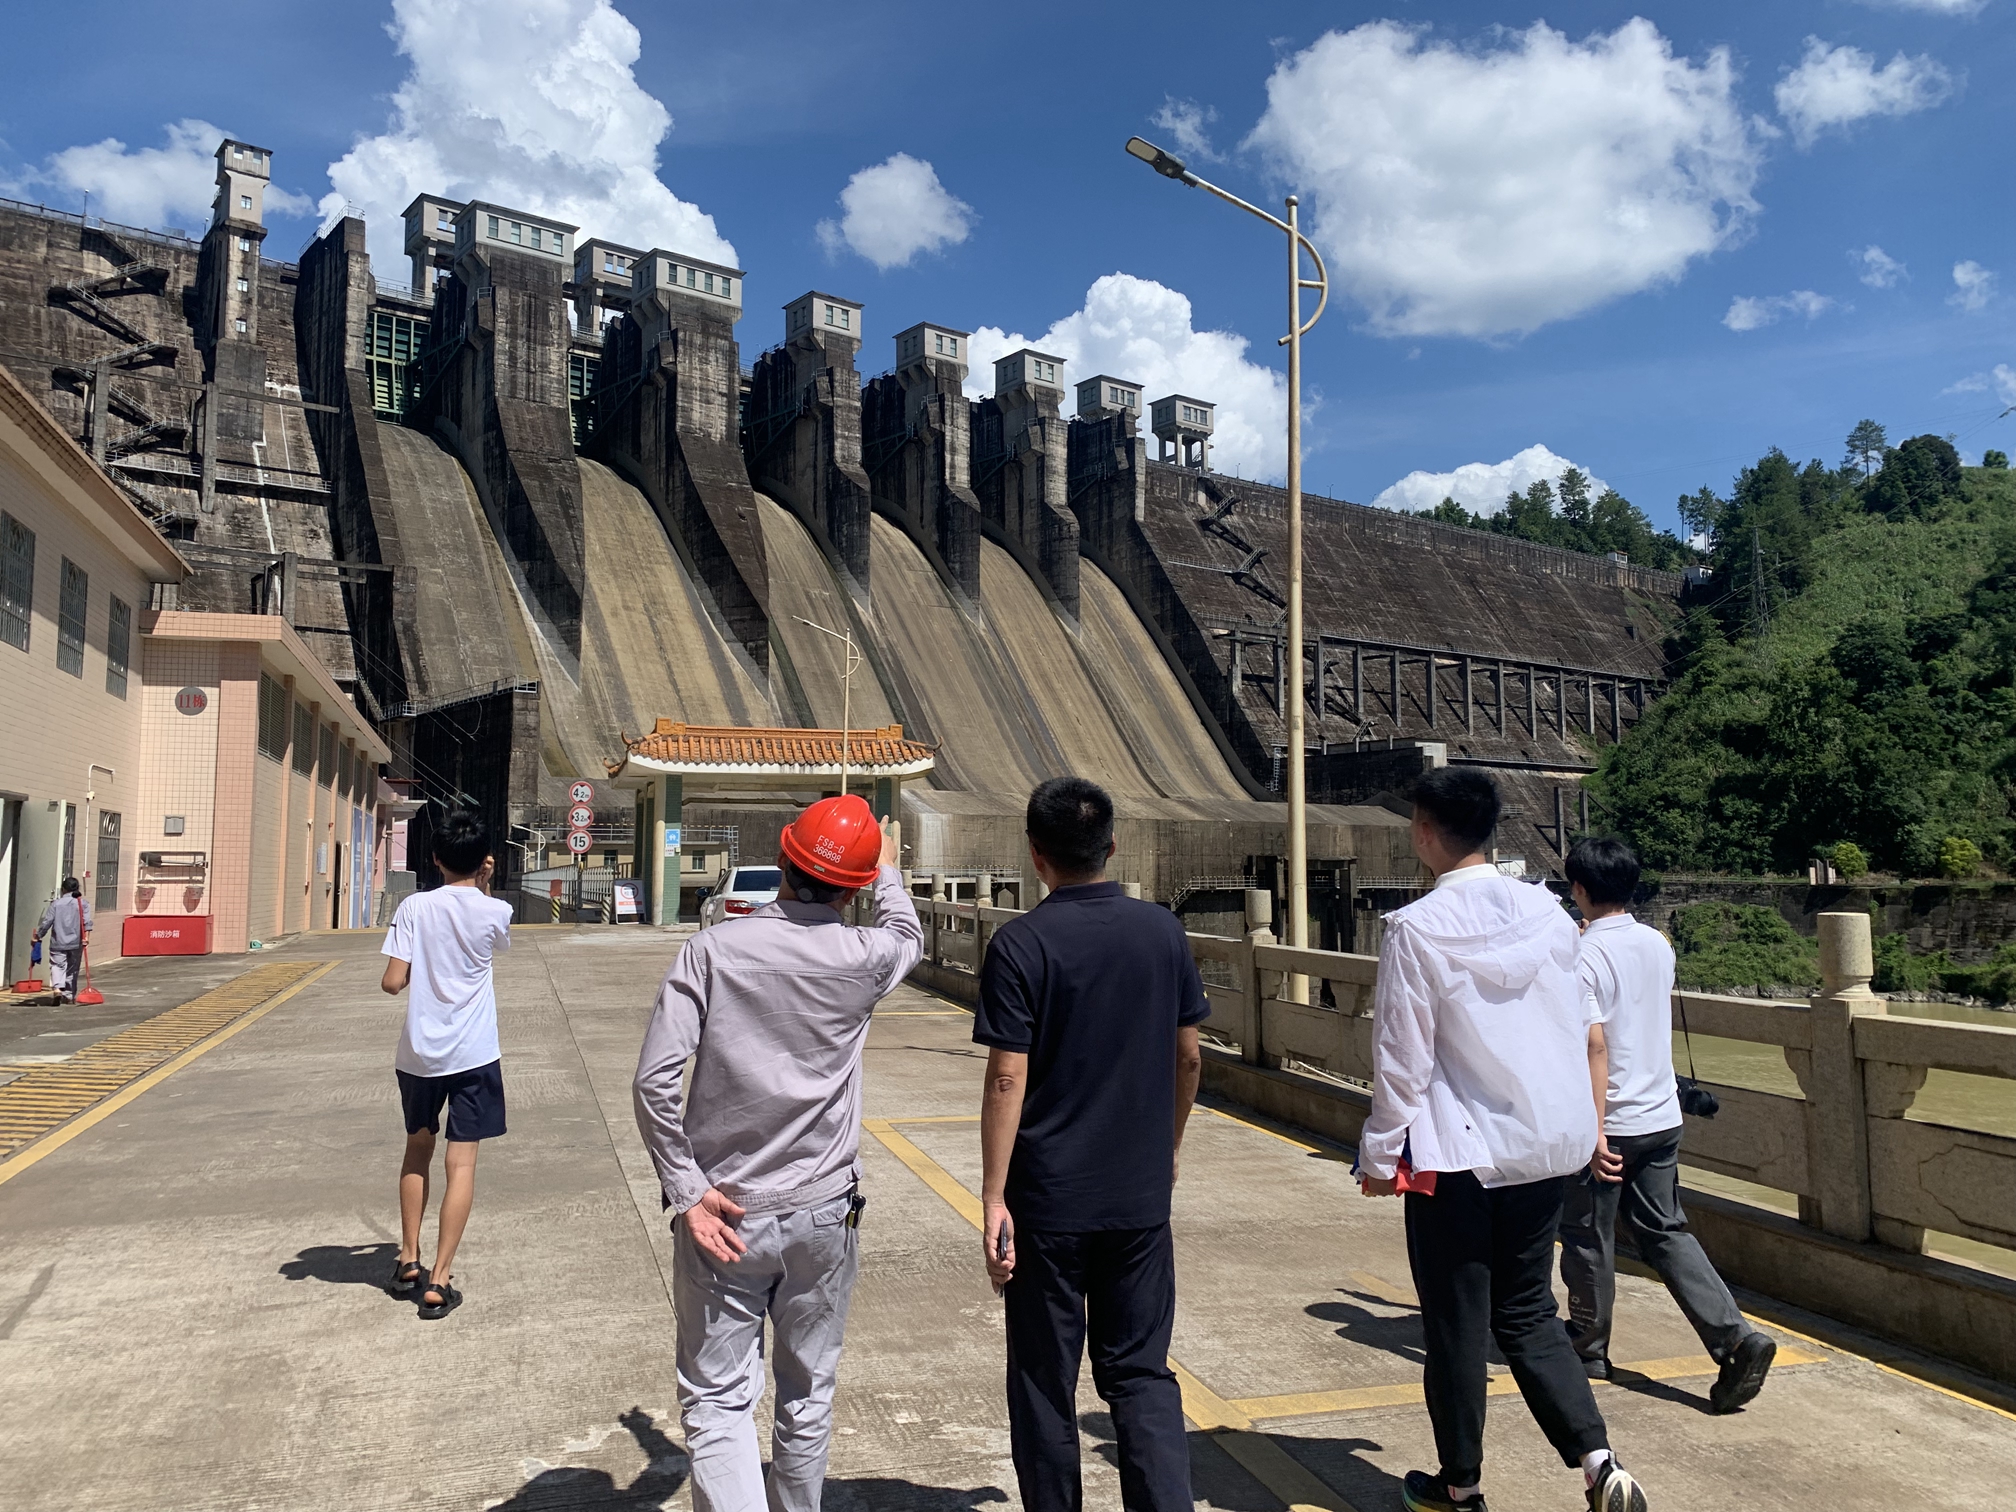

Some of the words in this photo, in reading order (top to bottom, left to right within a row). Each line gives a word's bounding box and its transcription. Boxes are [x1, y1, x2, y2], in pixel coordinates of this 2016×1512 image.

[179, 694, 205, 708] 11栋
[573, 788, 590, 798] 4.2m
[574, 812, 588, 822] 3.2m
[573, 836, 586, 848] 15
[817, 835, 845, 854] FSB-D
[813, 844, 842, 864] 366898
[150, 930, 181, 939] 消防沙箱
